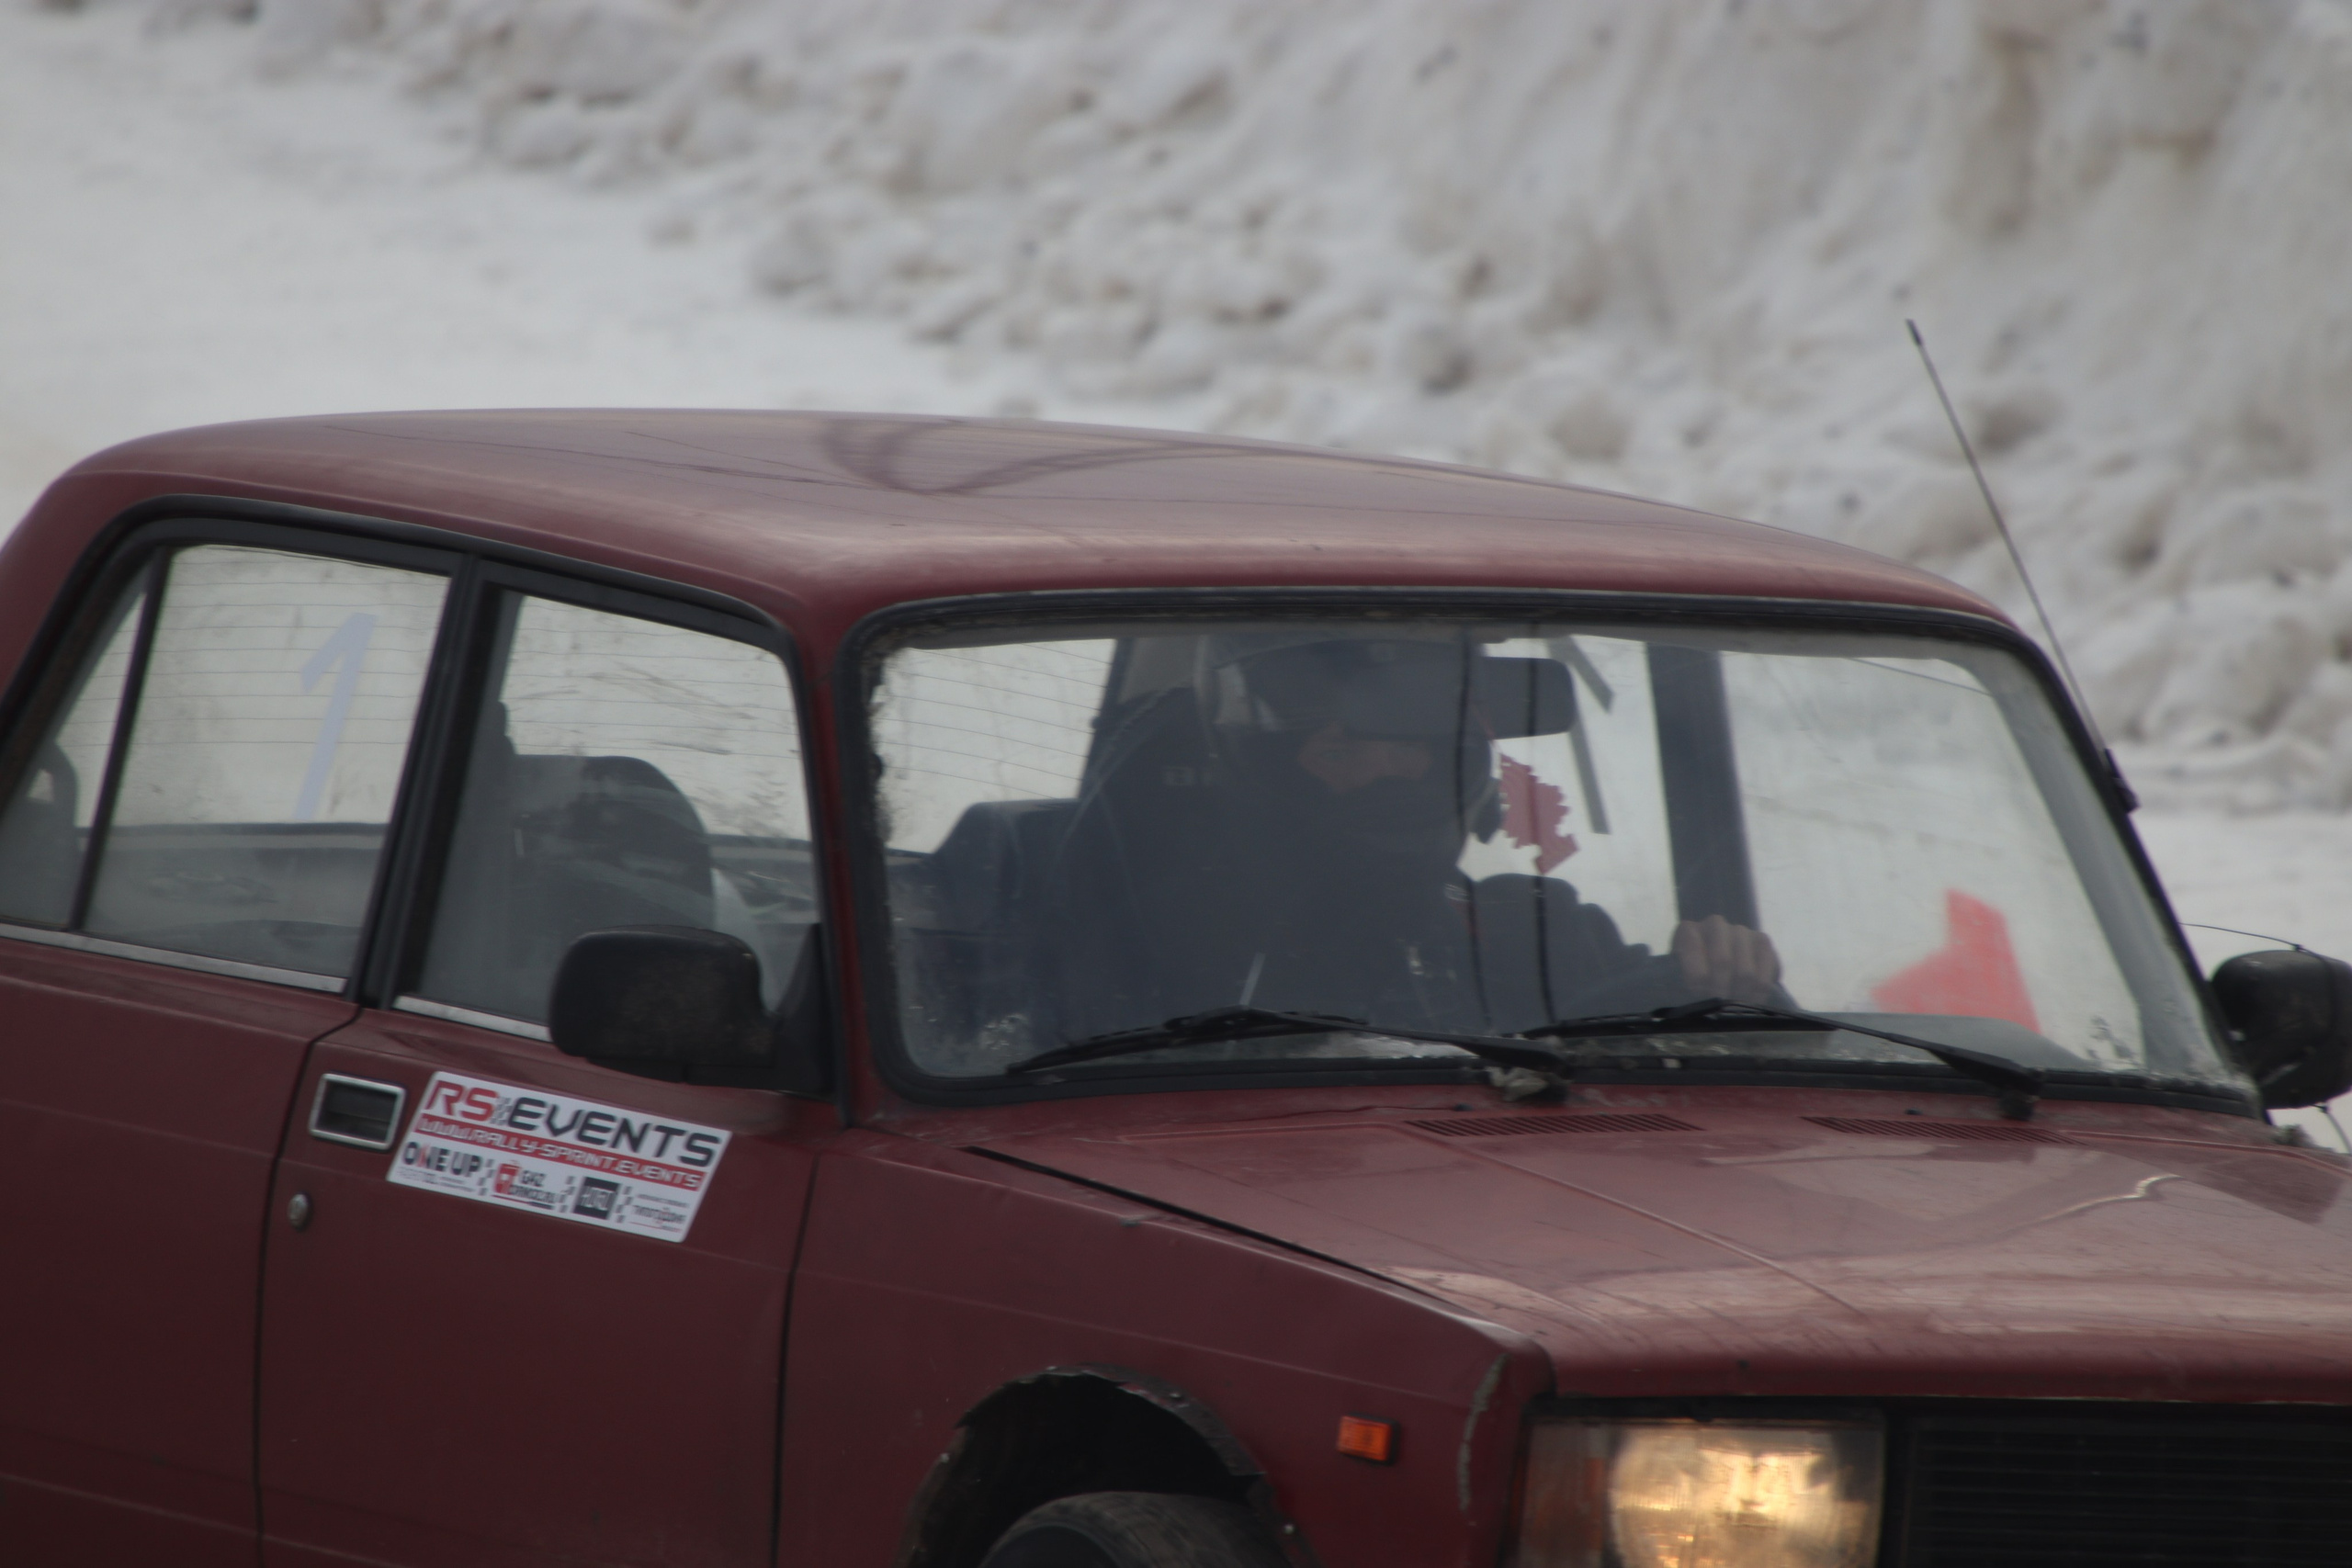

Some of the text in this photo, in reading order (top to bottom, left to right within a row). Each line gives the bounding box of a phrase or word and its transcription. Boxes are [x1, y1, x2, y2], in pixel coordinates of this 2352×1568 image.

[300, 612, 378, 822] 1
[402, 1141, 481, 1175] ONE UP
[424, 1079, 721, 1168] RS EVENTS
